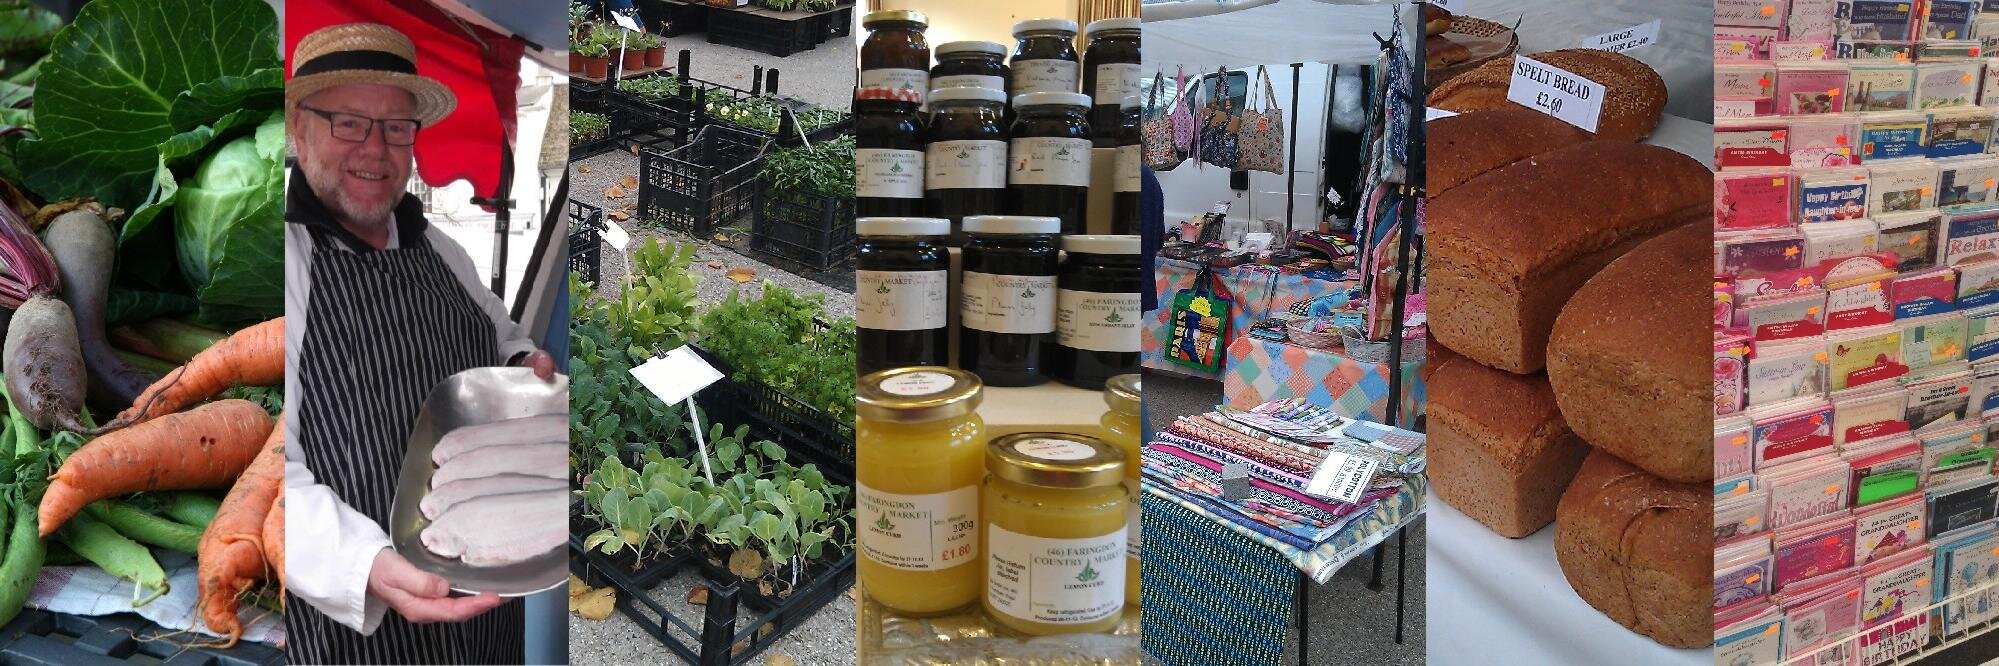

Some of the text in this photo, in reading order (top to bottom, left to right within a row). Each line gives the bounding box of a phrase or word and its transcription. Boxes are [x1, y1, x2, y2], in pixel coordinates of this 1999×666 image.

[1599, 29, 1634, 45] LARGE
[1516, 61, 1590, 100] SPELT BREAD
[1536, 91, 1563, 113] £2.60
[1805, 186, 1864, 203] Happy Birthday
[1949, 238, 1998, 256] Relax
[1170, 310, 1187, 359] PARIS
[1342, 459, 1370, 499] POLYCOTTON
[889, 510, 928, 520] MARKET
[942, 543, 971, 561] £1.80
[1067, 541, 1116, 557] FARINGDON
[1034, 557, 1082, 567] COUNTRY
